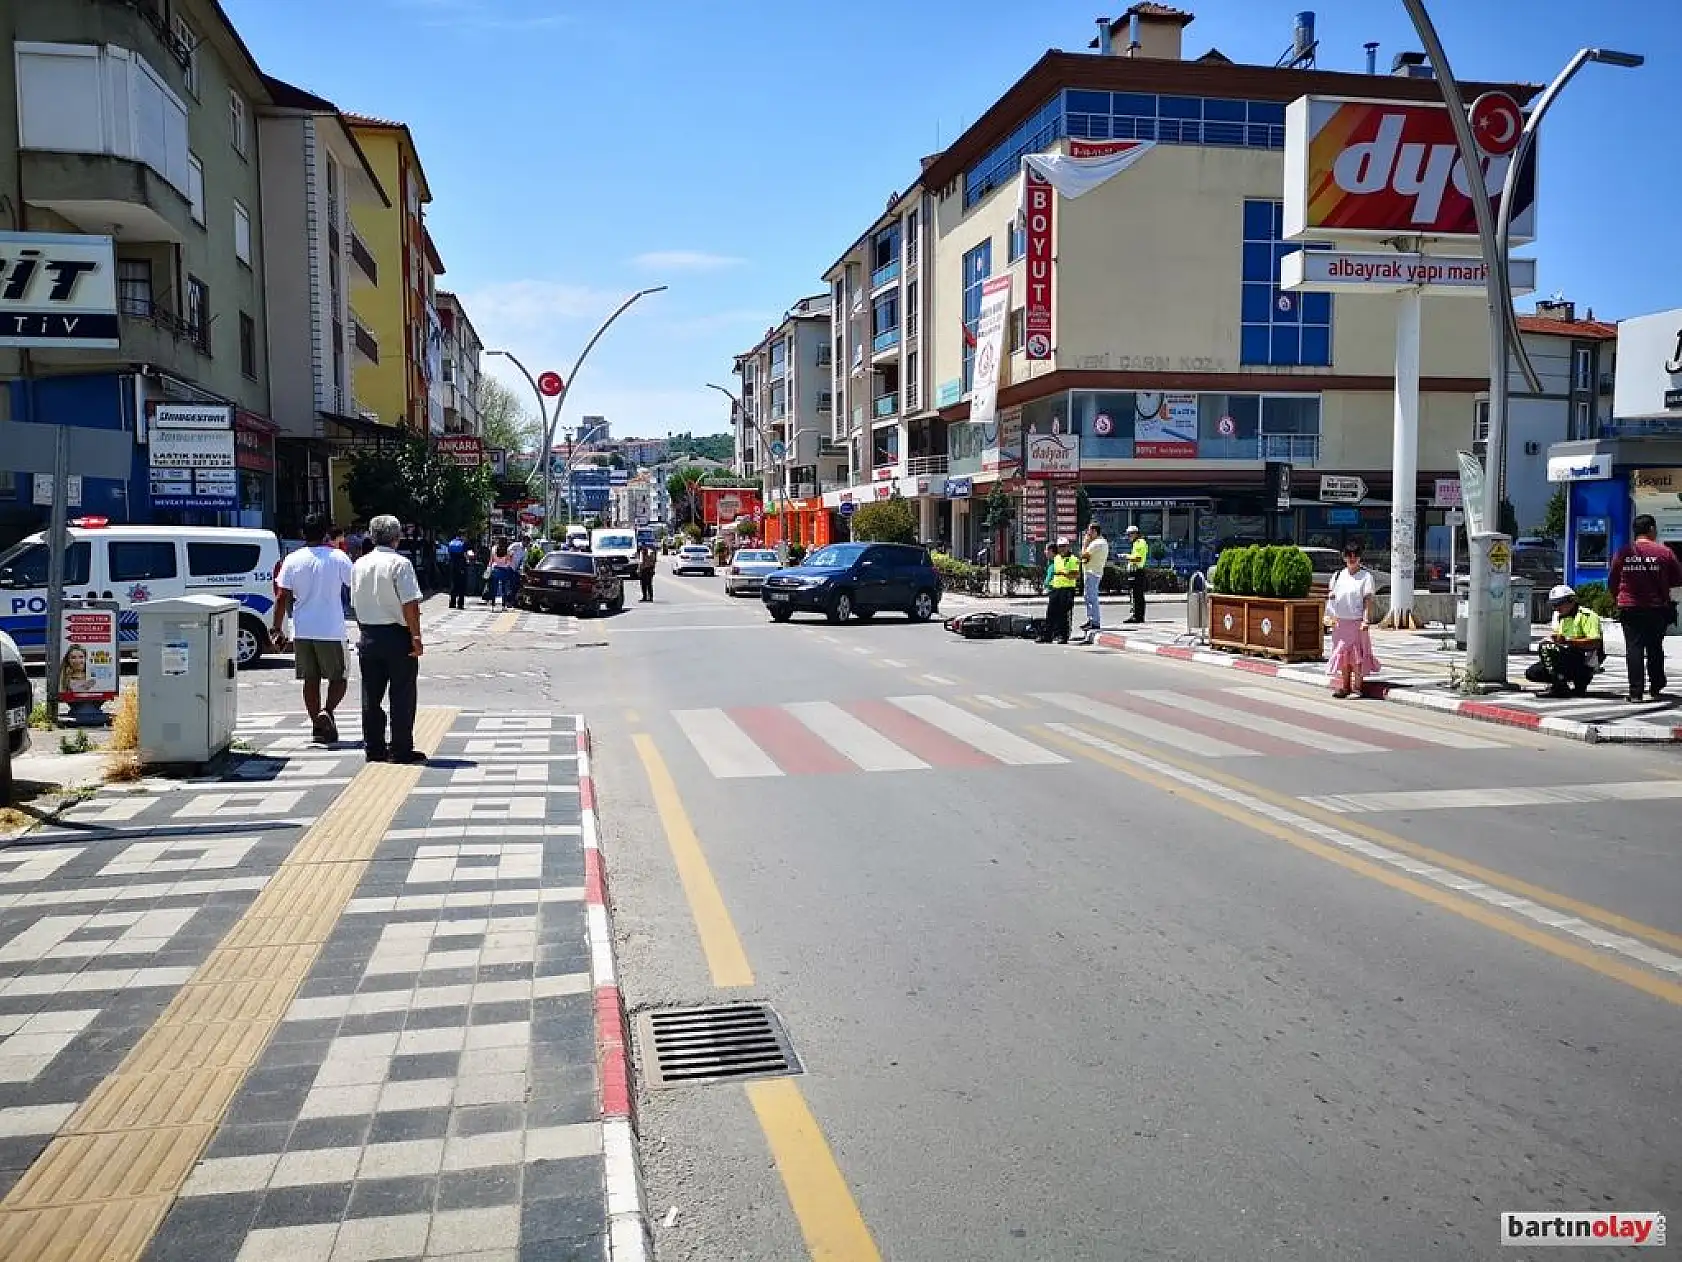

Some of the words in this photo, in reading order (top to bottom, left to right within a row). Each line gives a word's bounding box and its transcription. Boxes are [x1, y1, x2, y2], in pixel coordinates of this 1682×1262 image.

[1032, 191, 1048, 302] BOYUT
[1328, 258, 1402, 281] albayrak
[1407, 264, 1442, 282] yapı
[438, 439, 479, 451] ANKARA
[1032, 446, 1069, 462] dalyan
[254, 572, 272, 581] 155
